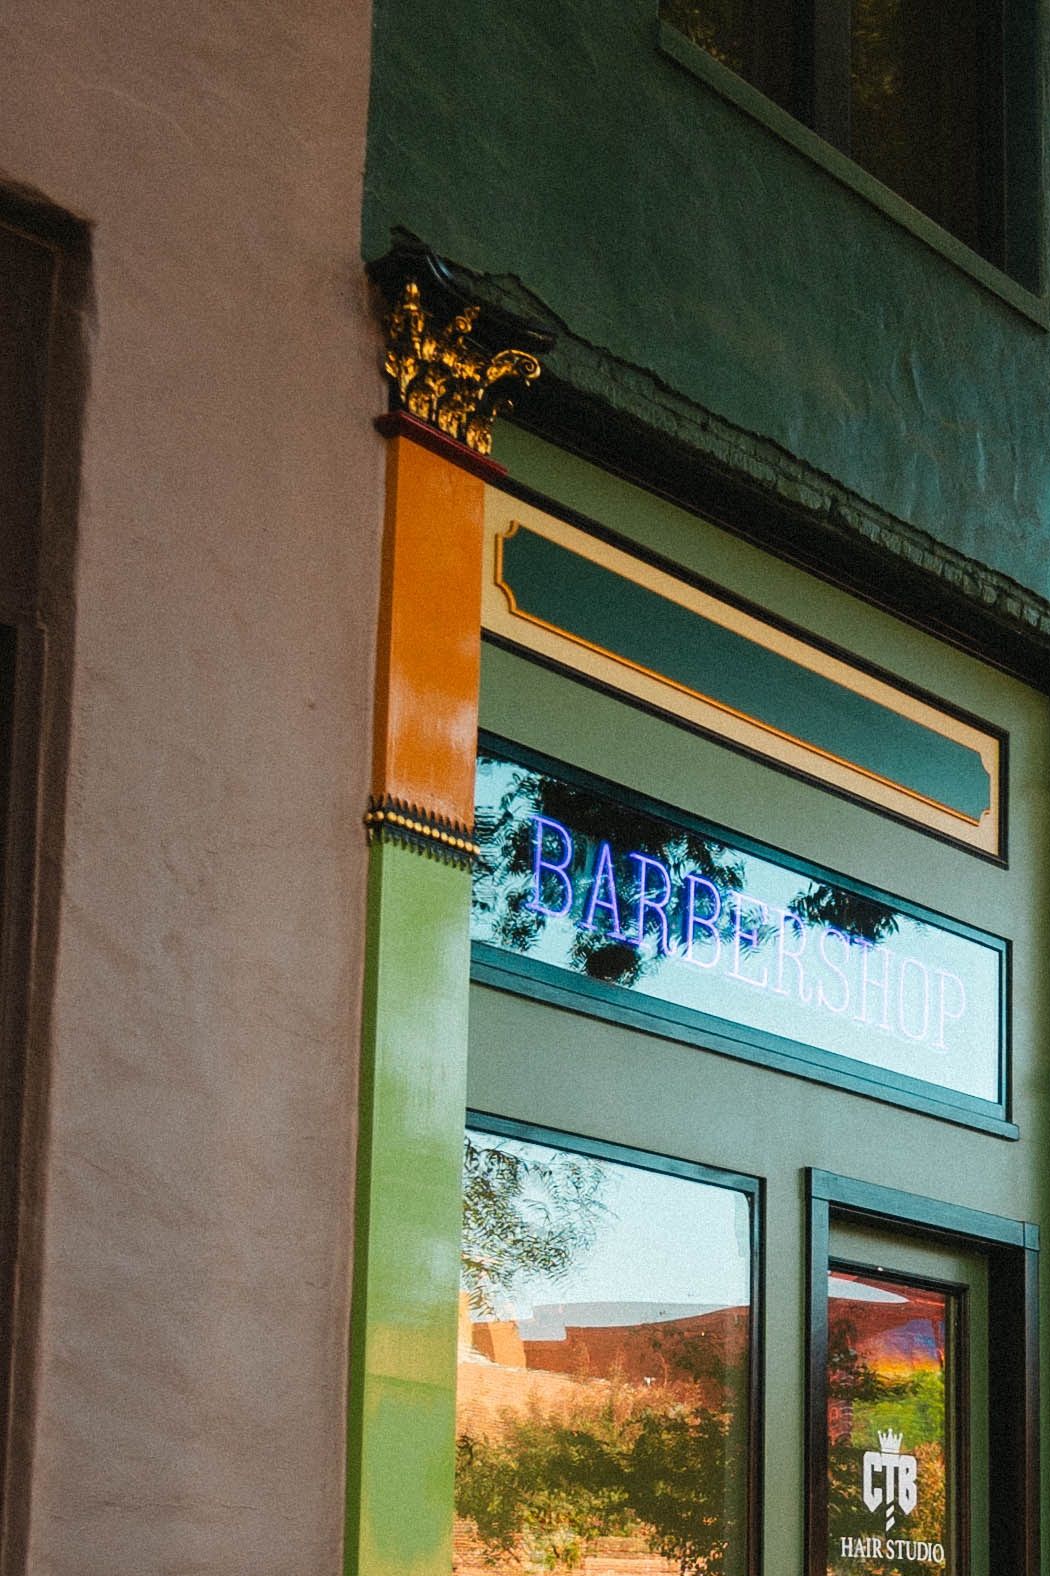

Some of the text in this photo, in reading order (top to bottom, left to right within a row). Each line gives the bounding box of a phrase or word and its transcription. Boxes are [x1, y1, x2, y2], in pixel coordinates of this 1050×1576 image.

[526, 815, 967, 1051] BARBERSHOP
[863, 1451, 917, 1524] CTB
[840, 1536, 945, 1564] HAIR STUDIO
